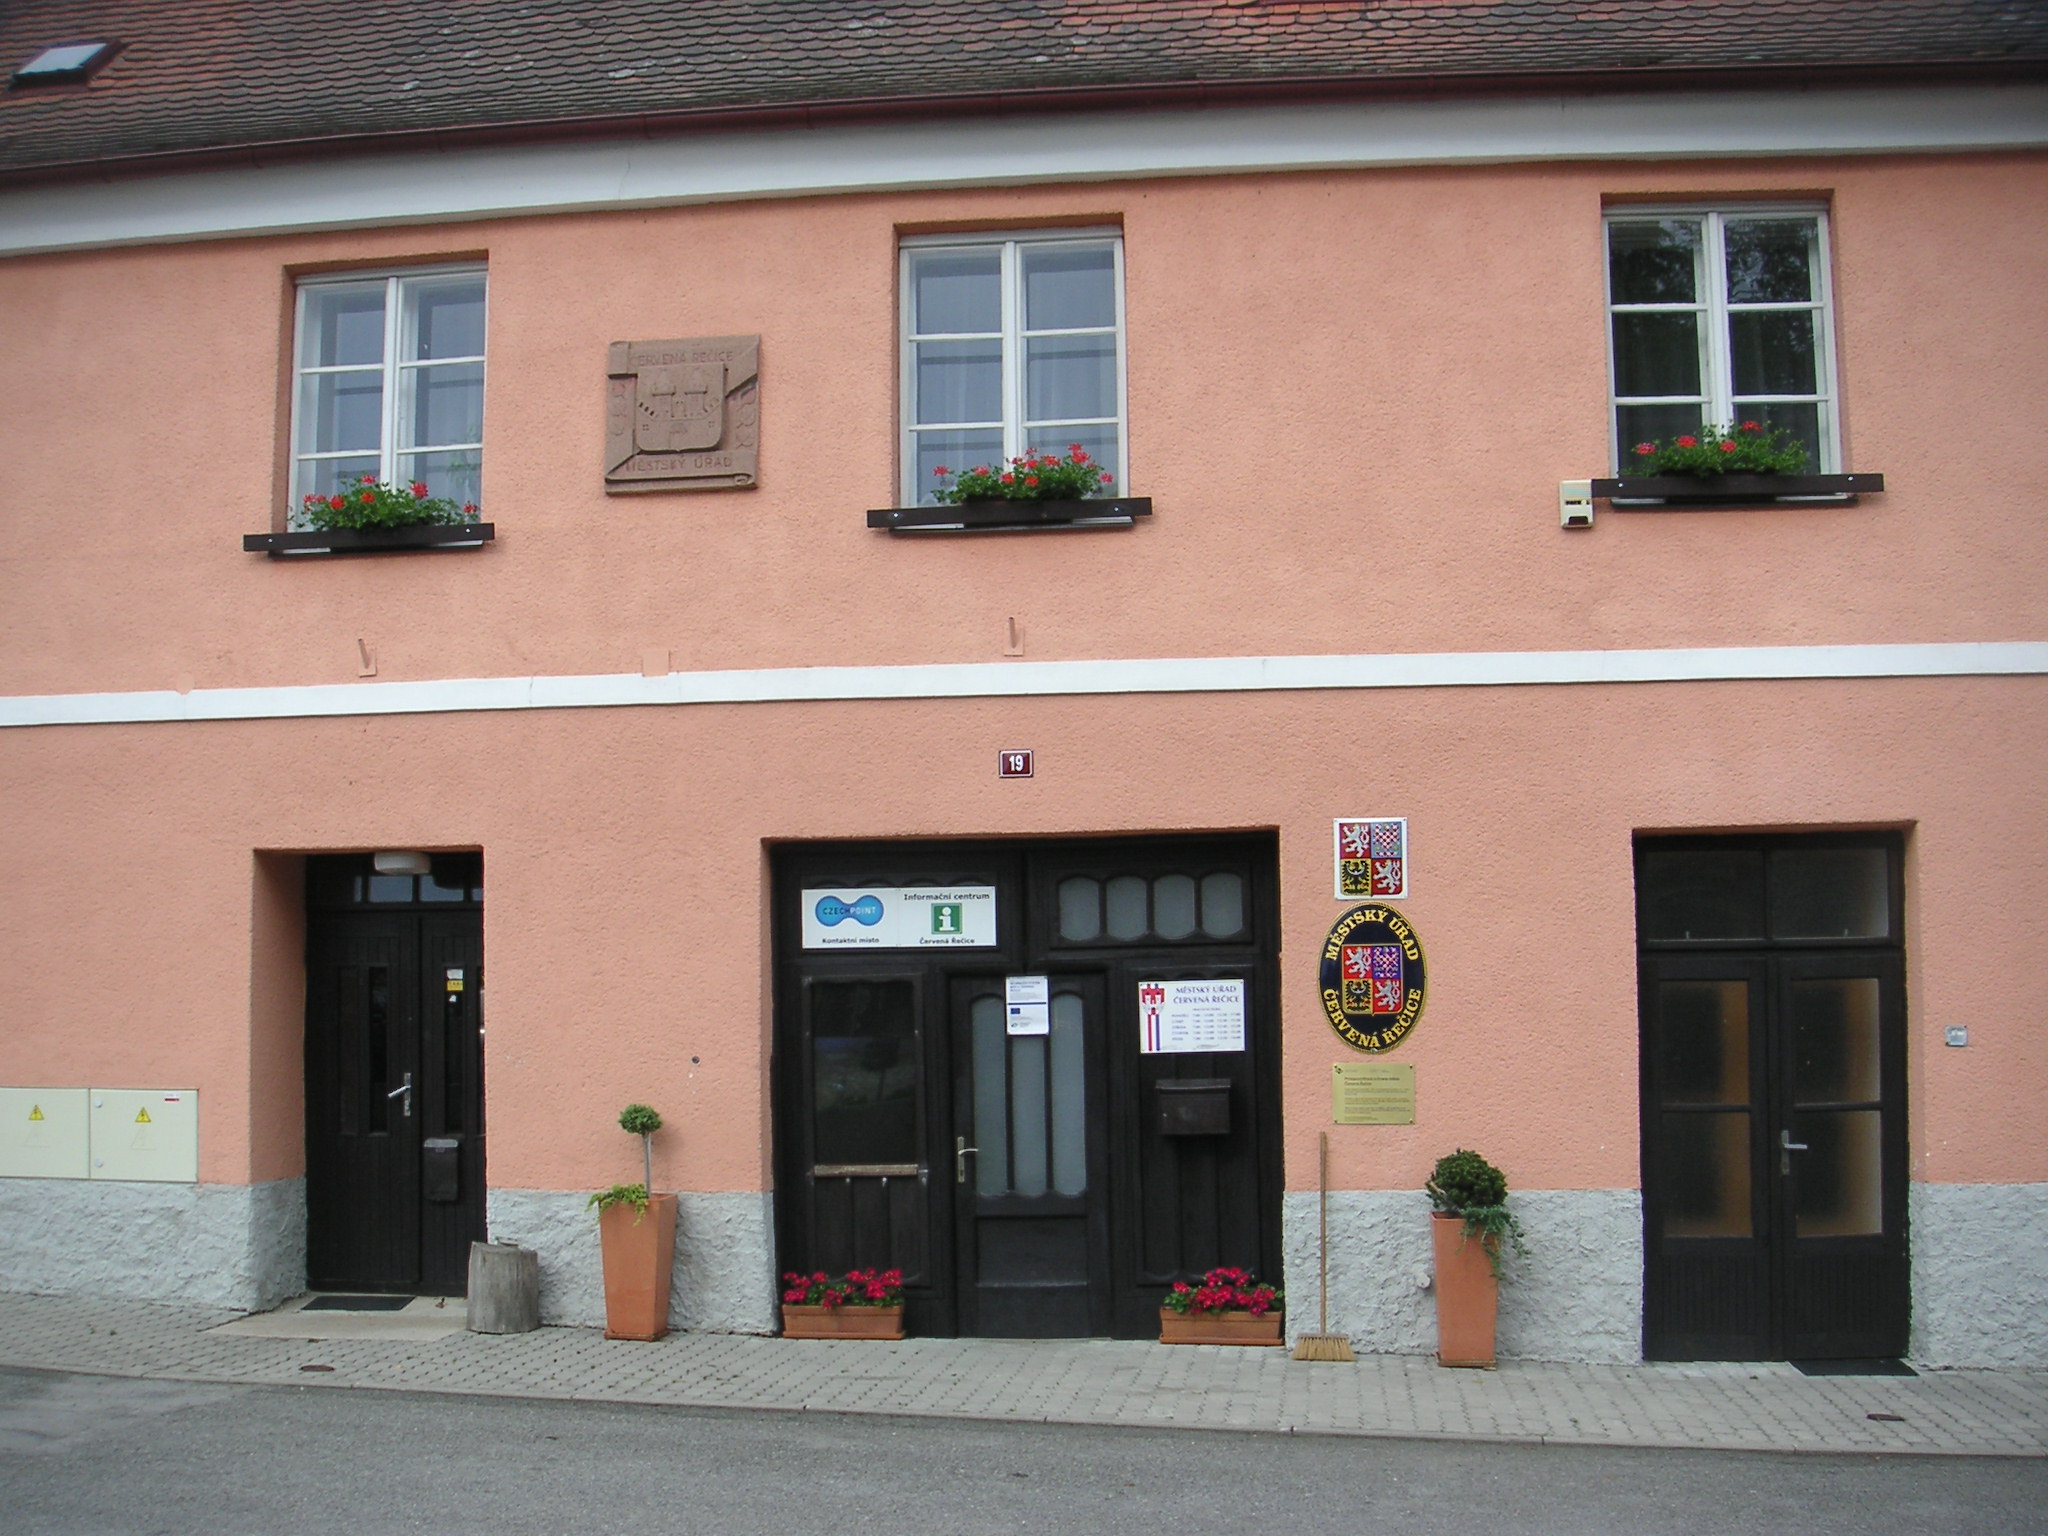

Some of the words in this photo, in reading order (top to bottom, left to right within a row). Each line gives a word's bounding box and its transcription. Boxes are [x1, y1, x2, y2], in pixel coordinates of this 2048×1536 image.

[1009, 754, 1024, 772] 19
[903, 893, 952, 901] Informační
[1325, 907, 1388, 961] MĚSTSKÝ
[1388, 917, 1419, 961] ÚŘAD
[919, 937, 949, 945] Červená
[1173, 995, 1210, 1004] ČERVENÁ
[1324, 988, 1381, 1048] ČERVENÁ
[1382, 988, 1422, 1045] ŘEČICE
